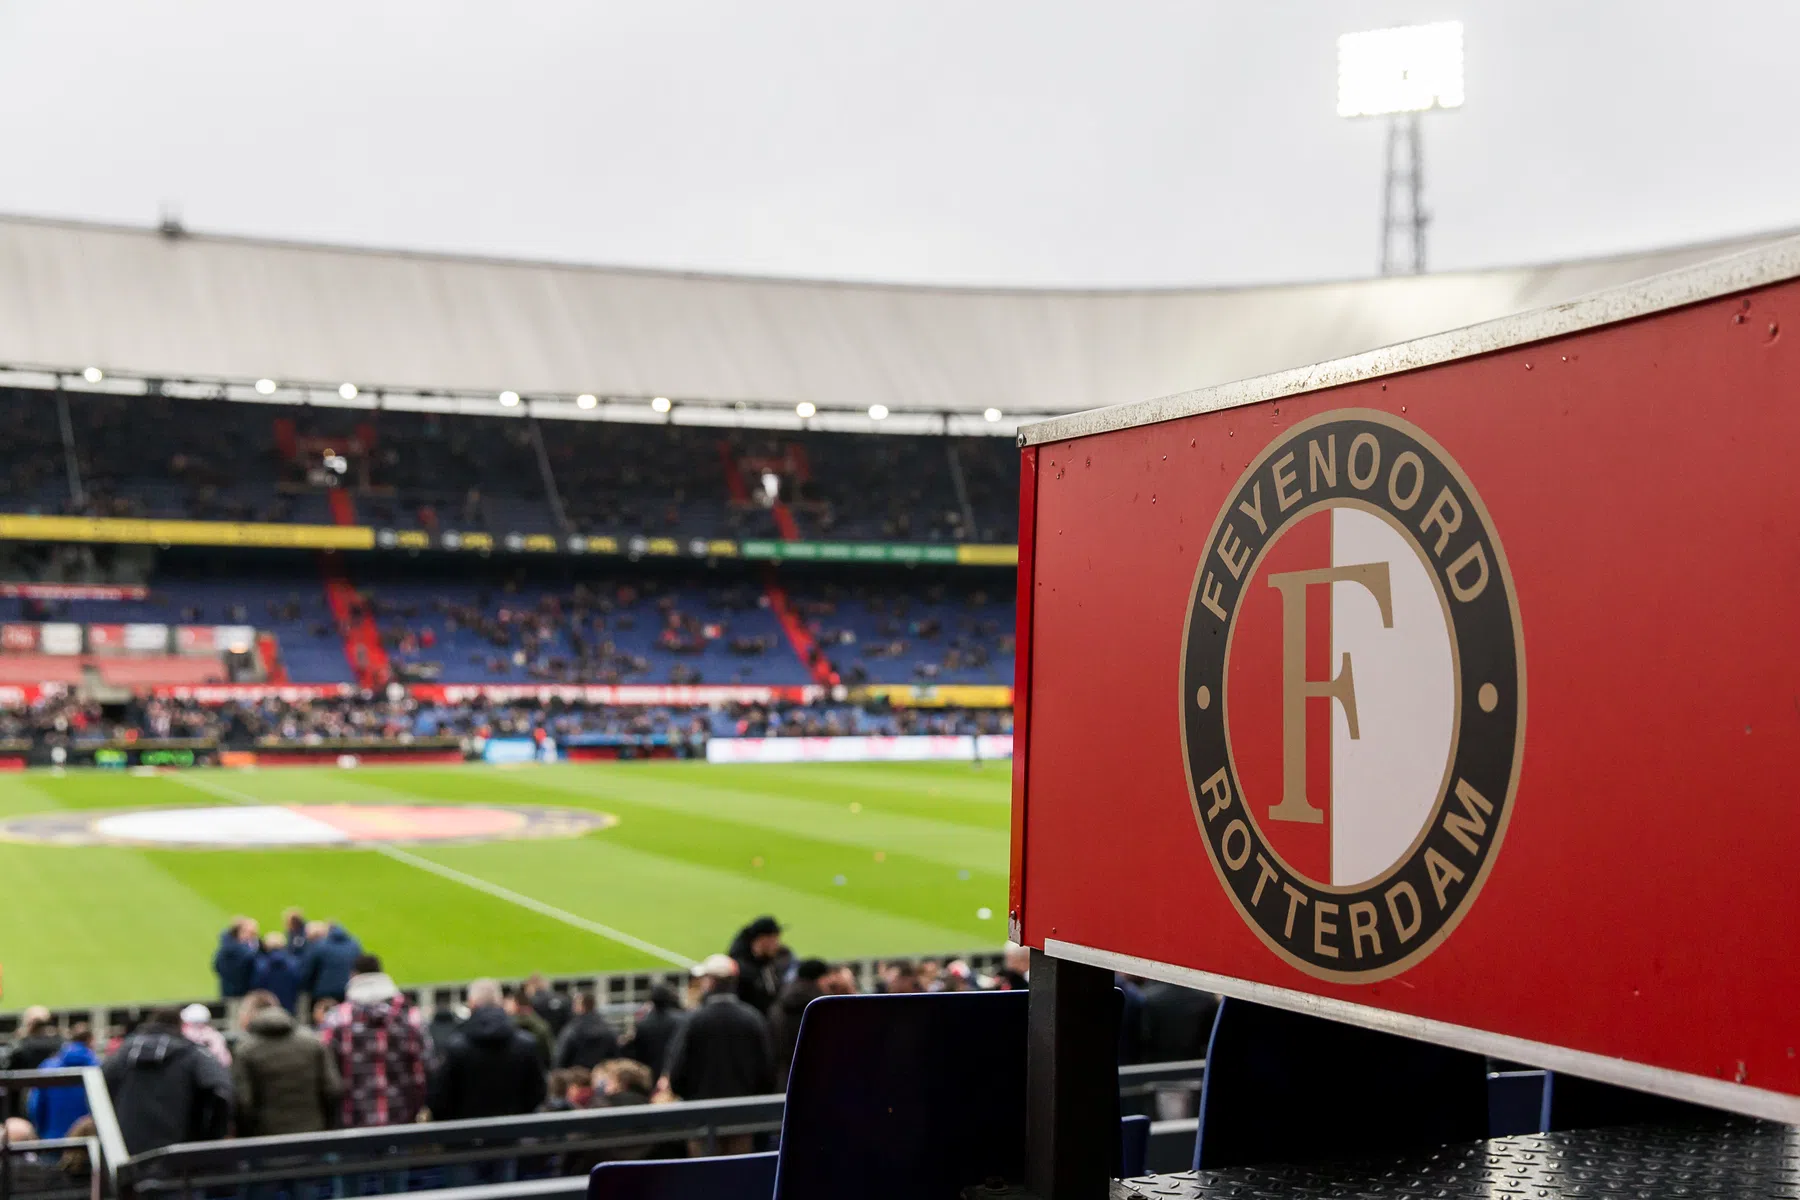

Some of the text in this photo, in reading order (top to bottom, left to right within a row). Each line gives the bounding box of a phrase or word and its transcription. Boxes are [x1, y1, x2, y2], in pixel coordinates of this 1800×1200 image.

[1201, 432, 1489, 623] FEYENOORD
[1267, 561, 1394, 824] F
[1200, 766, 1494, 959] ROTTERDAM
